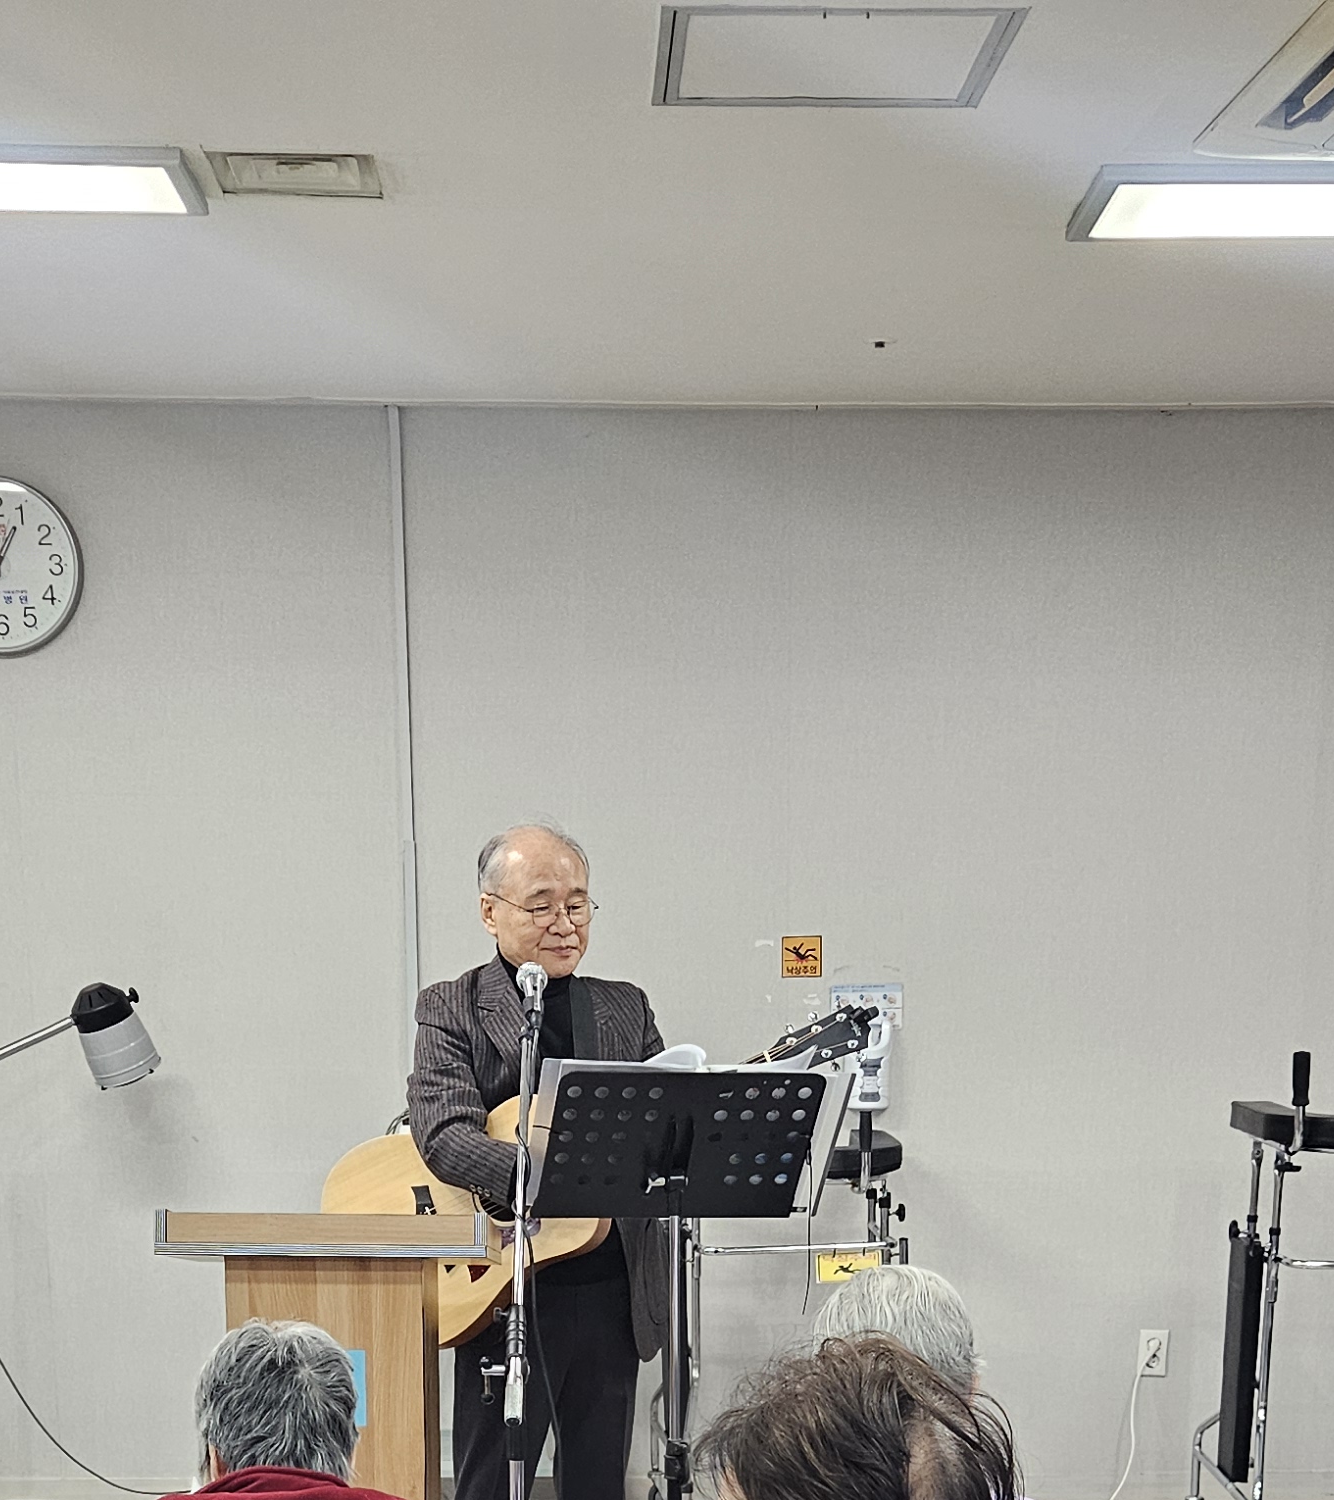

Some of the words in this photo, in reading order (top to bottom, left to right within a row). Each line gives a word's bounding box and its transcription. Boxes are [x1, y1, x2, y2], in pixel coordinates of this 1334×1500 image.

[14, 503, 24, 525] 1
[37, 524, 52, 545] 2
[48, 553, 64, 576] 3
[42, 584, 56, 606] 4
[23, 606, 37, 628] 5
[786, 965, 817, 976] 낙상주의
